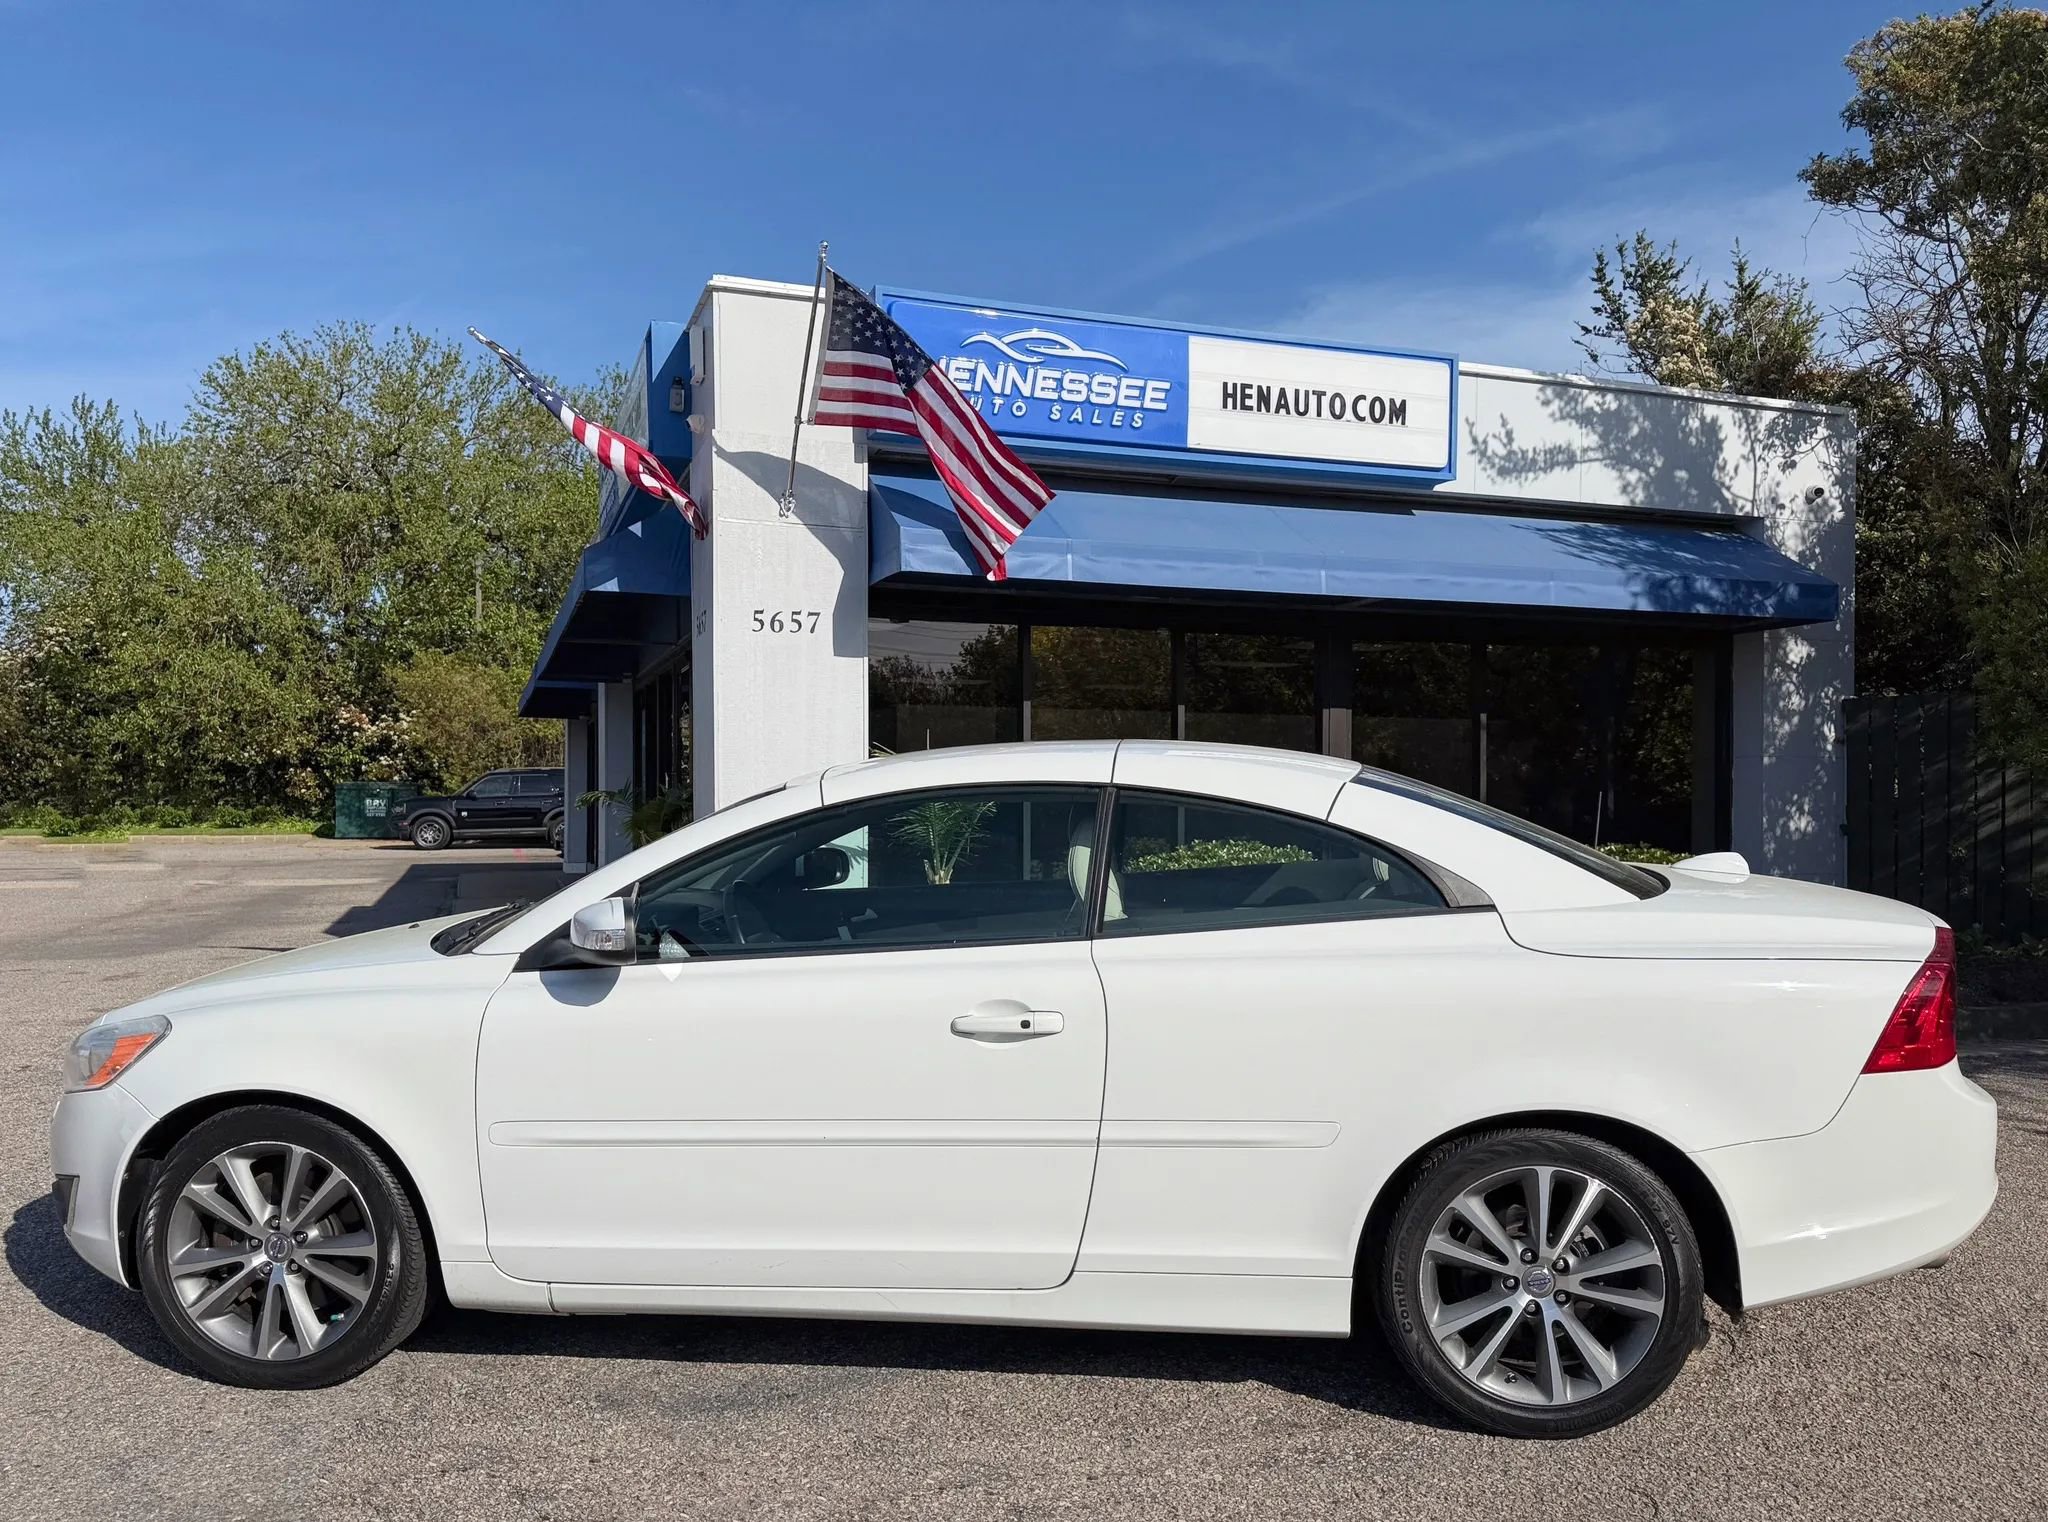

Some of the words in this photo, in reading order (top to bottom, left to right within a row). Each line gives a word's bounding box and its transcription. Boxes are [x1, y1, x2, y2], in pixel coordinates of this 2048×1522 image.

[939, 355, 1172, 412] ENNESSEE
[969, 394, 1027, 418] UTO
[1050, 406, 1145, 429] SALES
[752, 608, 821, 634] 5657
